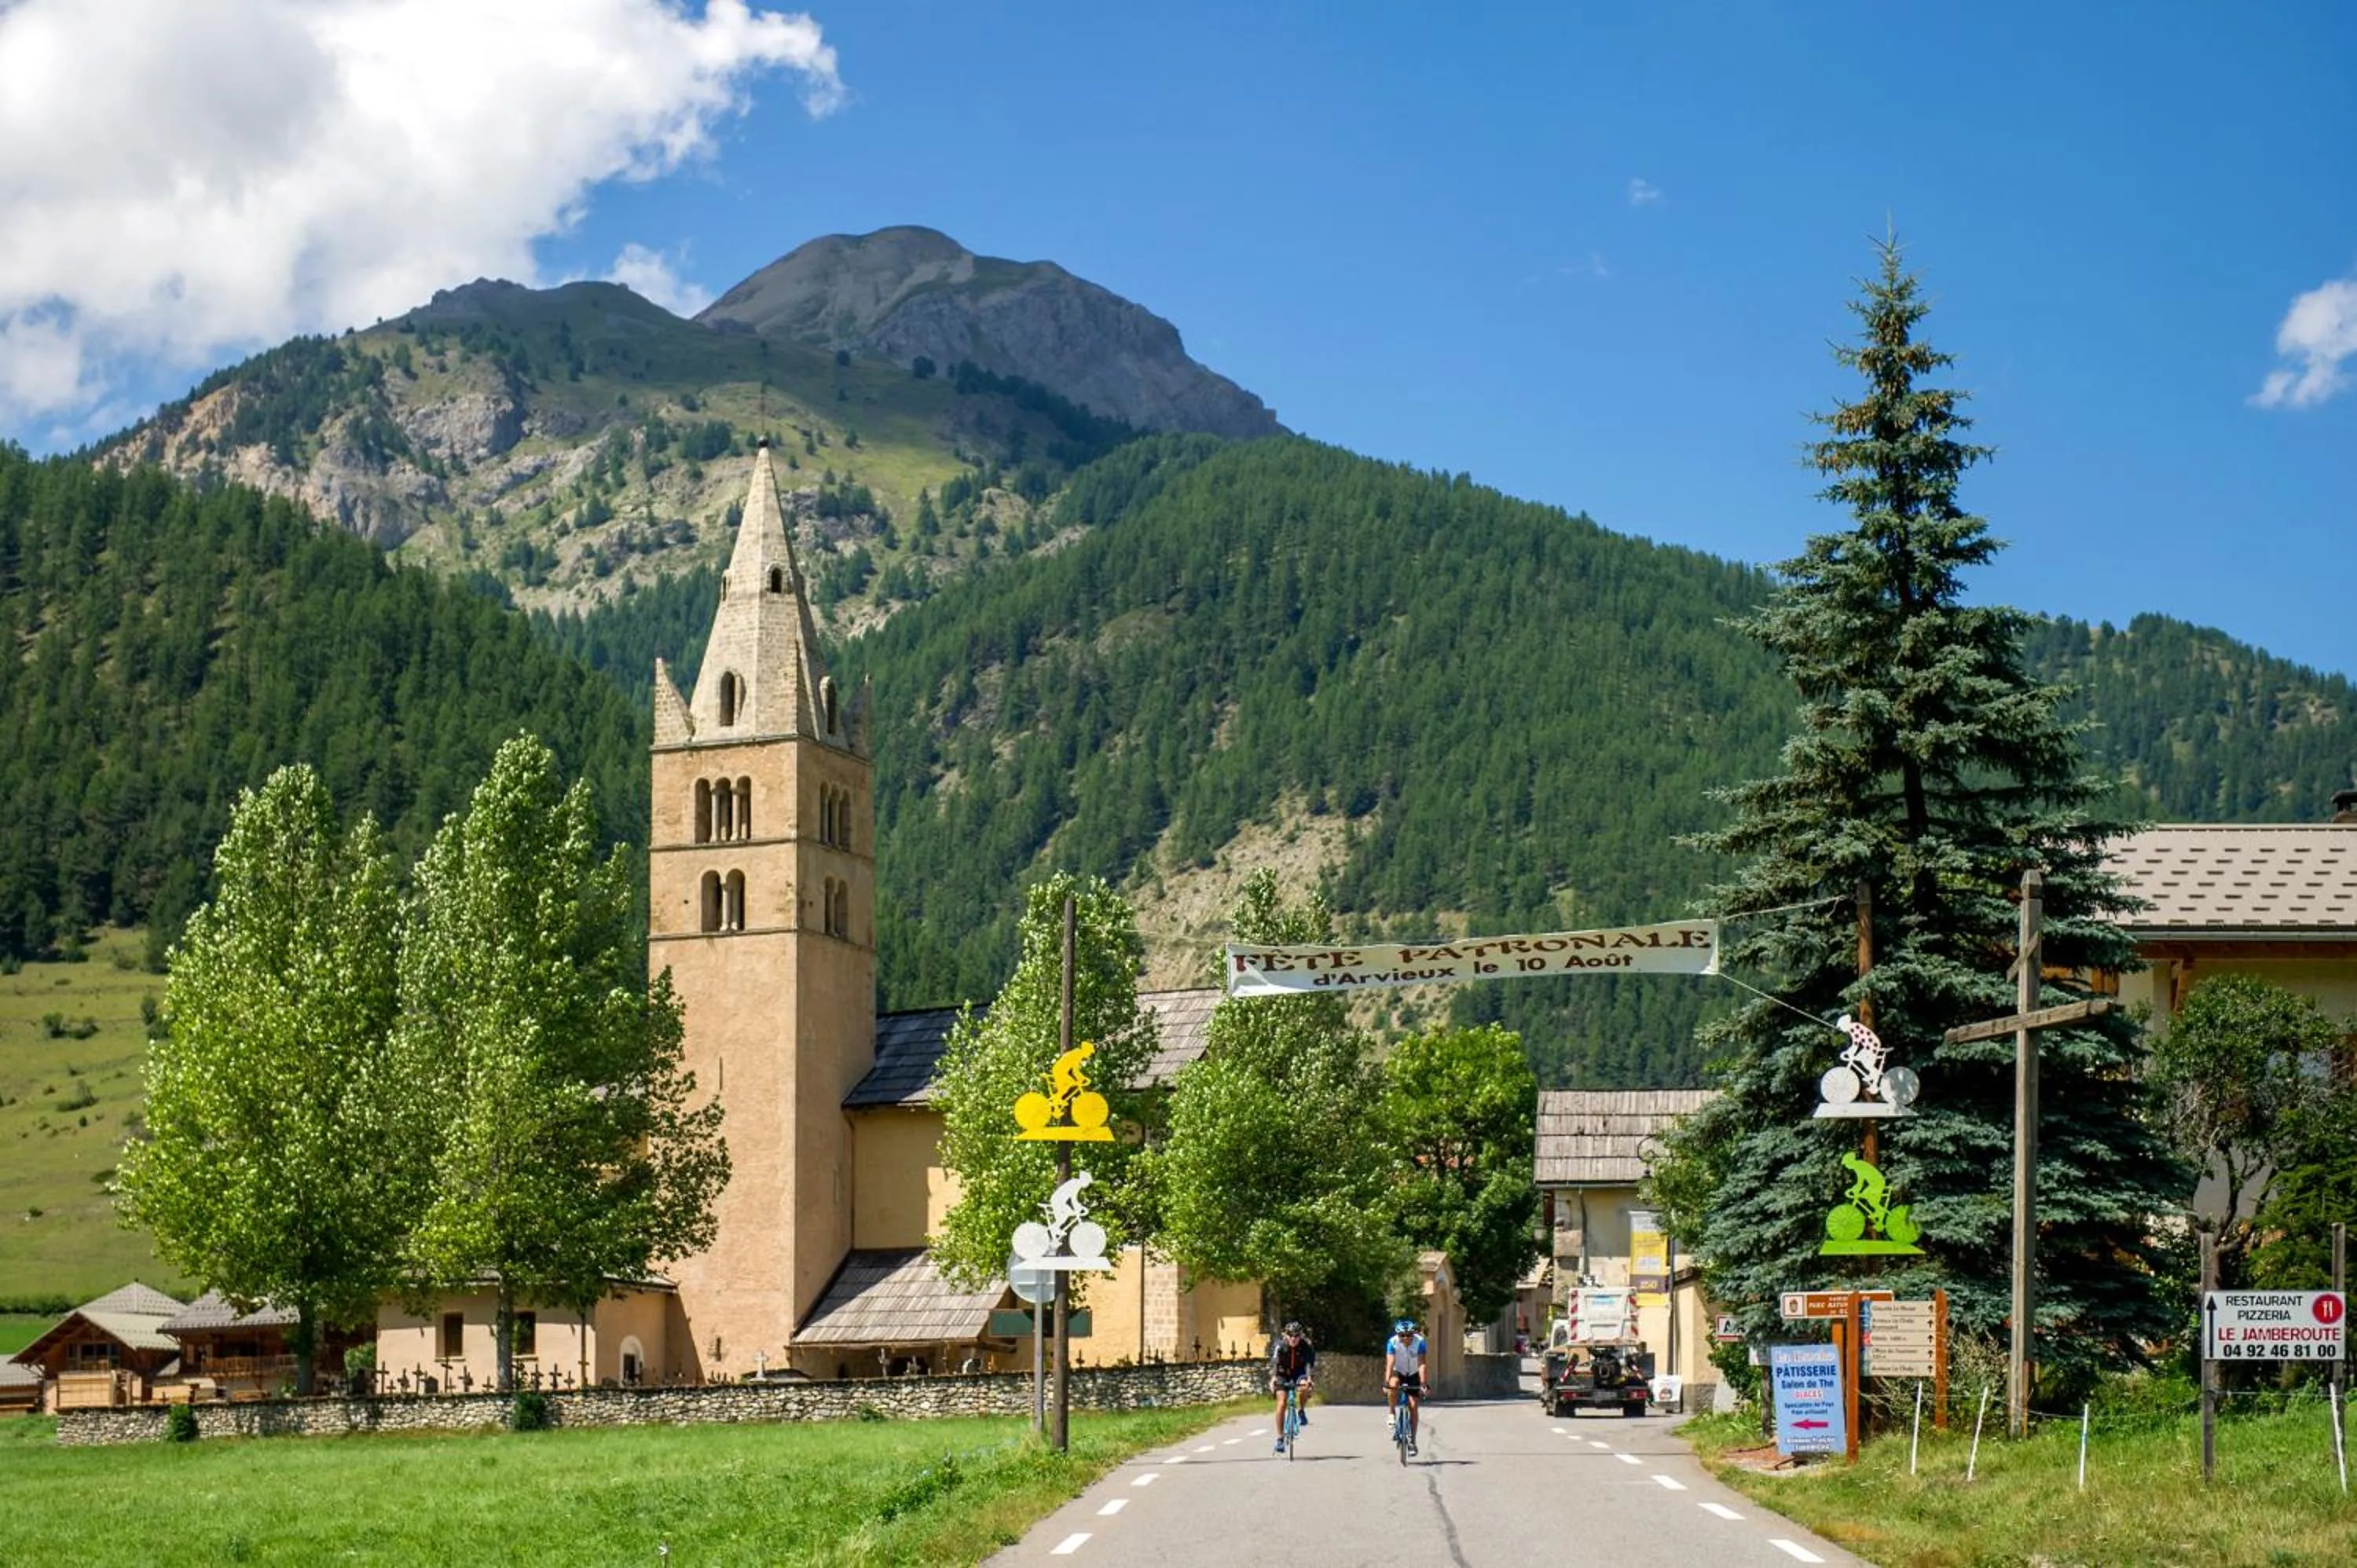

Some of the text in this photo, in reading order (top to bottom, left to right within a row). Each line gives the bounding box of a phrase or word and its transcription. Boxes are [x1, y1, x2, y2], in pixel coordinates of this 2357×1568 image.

[1233, 930, 1711, 972] FÊTE PATRONALE
[1313, 953, 1633, 986] d'Arvieux le 10 Août
[2226, 1295, 2304, 1306] RESTAURANT
[2238, 1310, 2292, 1321] PIZZERIA
[2218, 1328, 2341, 1341] LE JAMBEROUTE
[2223, 1344, 2336, 1357] 04 92 46 81 00
